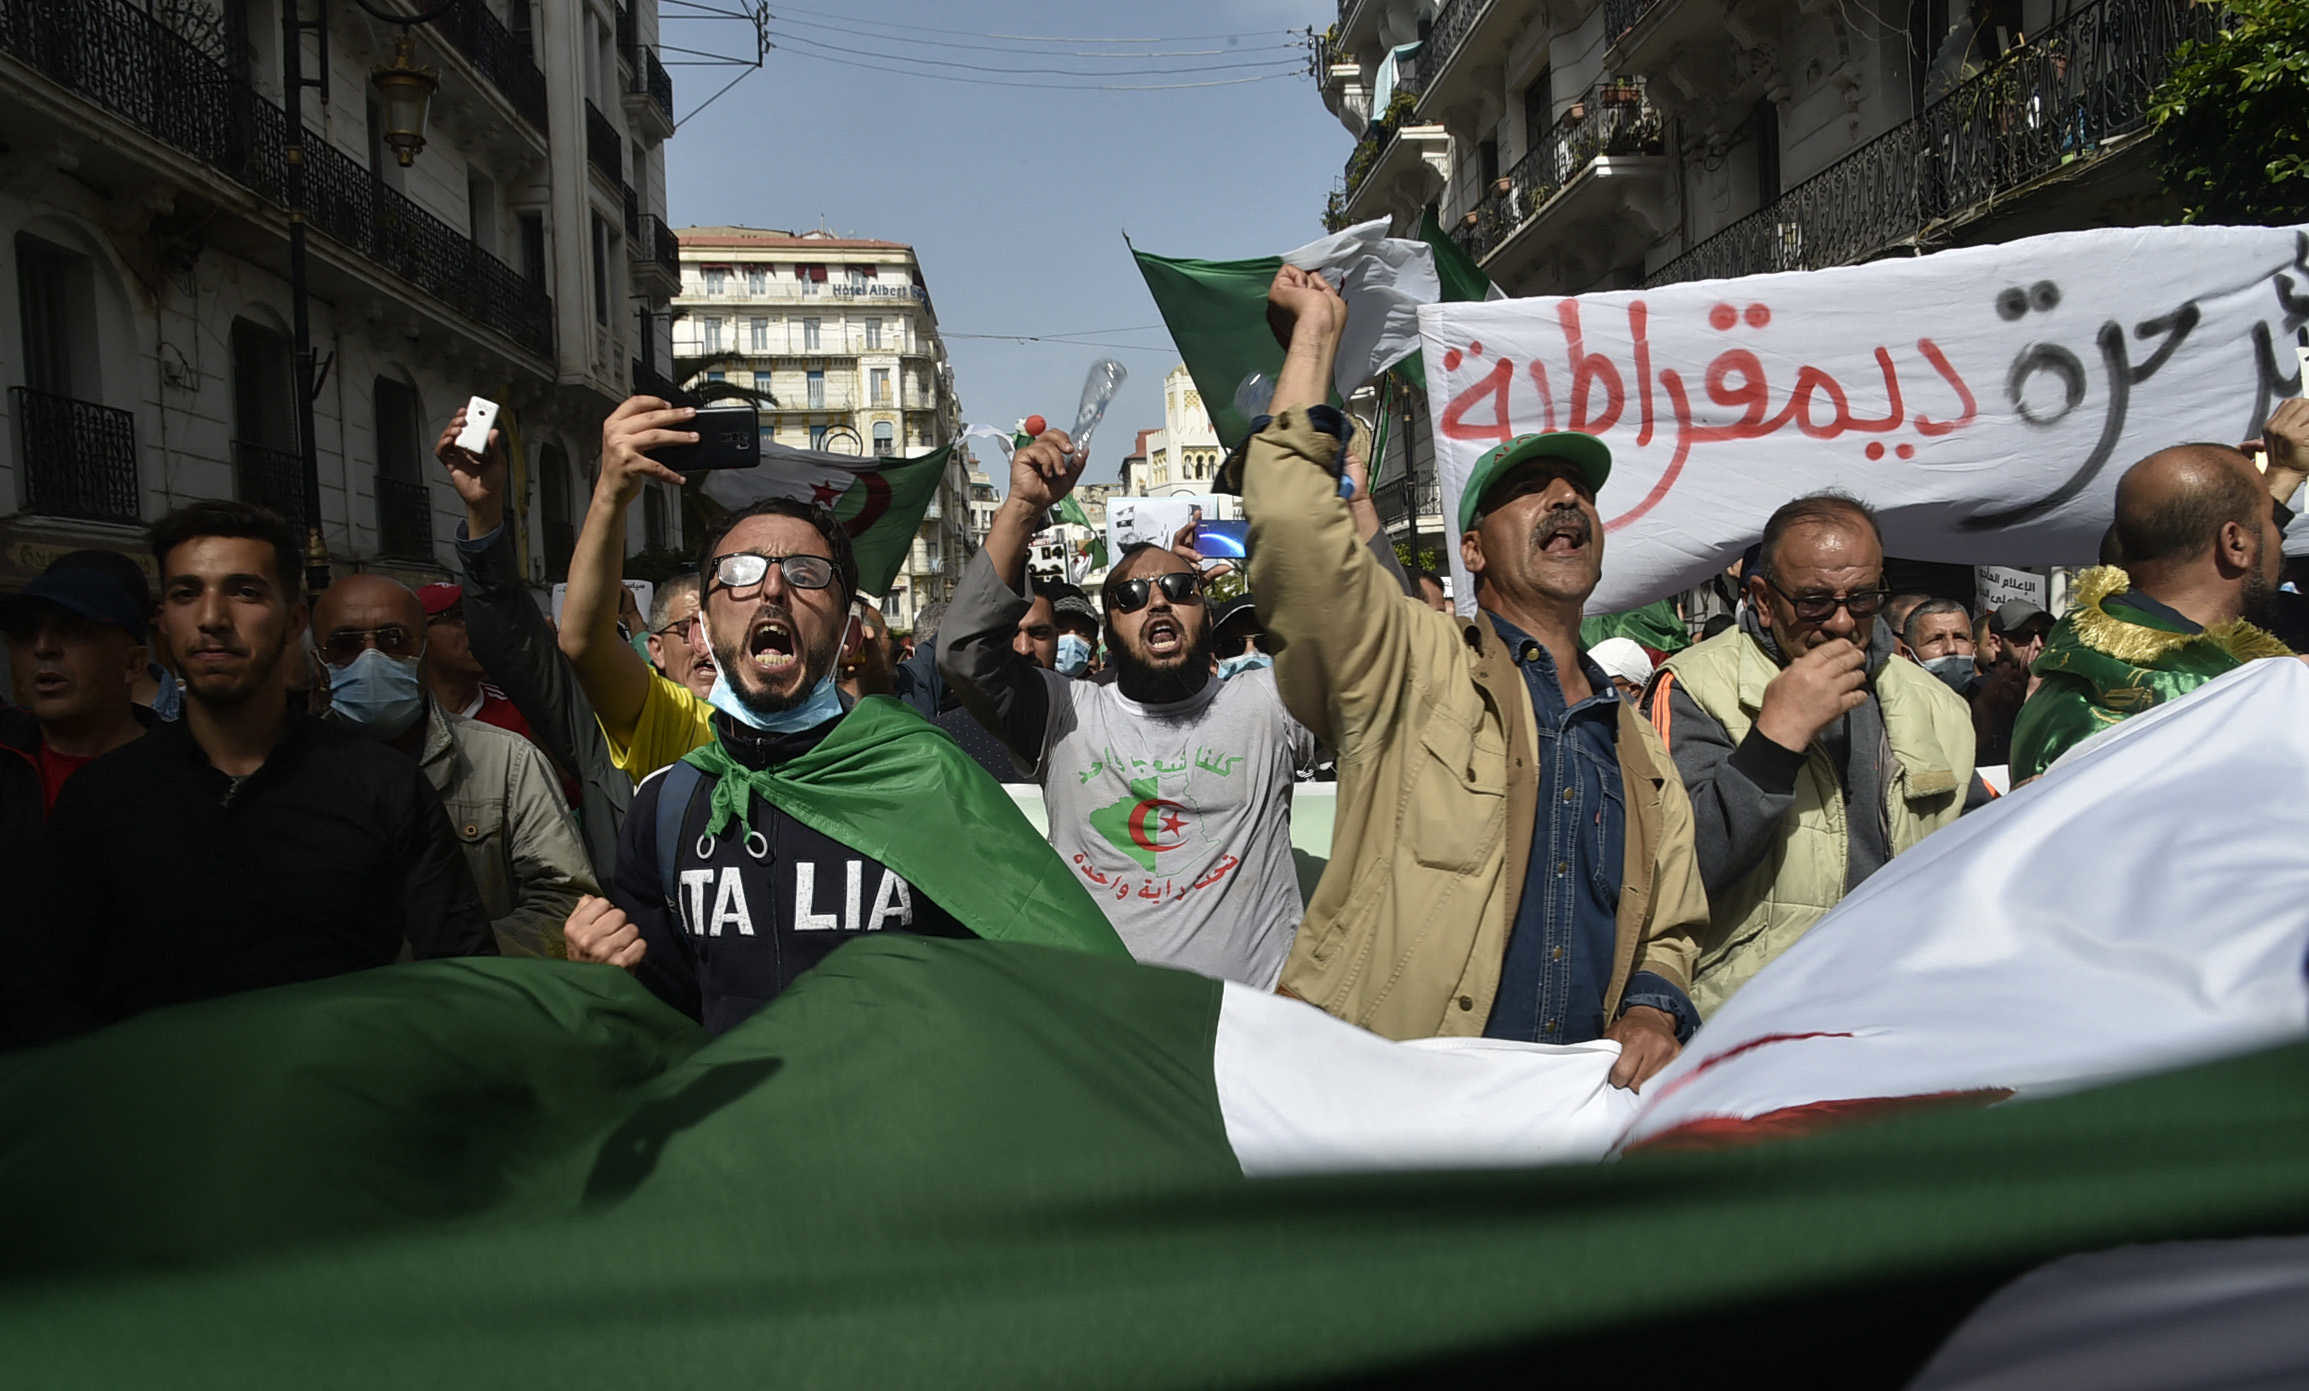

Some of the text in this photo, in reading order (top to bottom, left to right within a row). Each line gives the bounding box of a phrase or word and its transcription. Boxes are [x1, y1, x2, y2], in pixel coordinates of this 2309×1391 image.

[869, 284, 906, 297] Albert
[1953, 279, 2201, 533] حرة
[1138, 878, 1186, 904] راية
